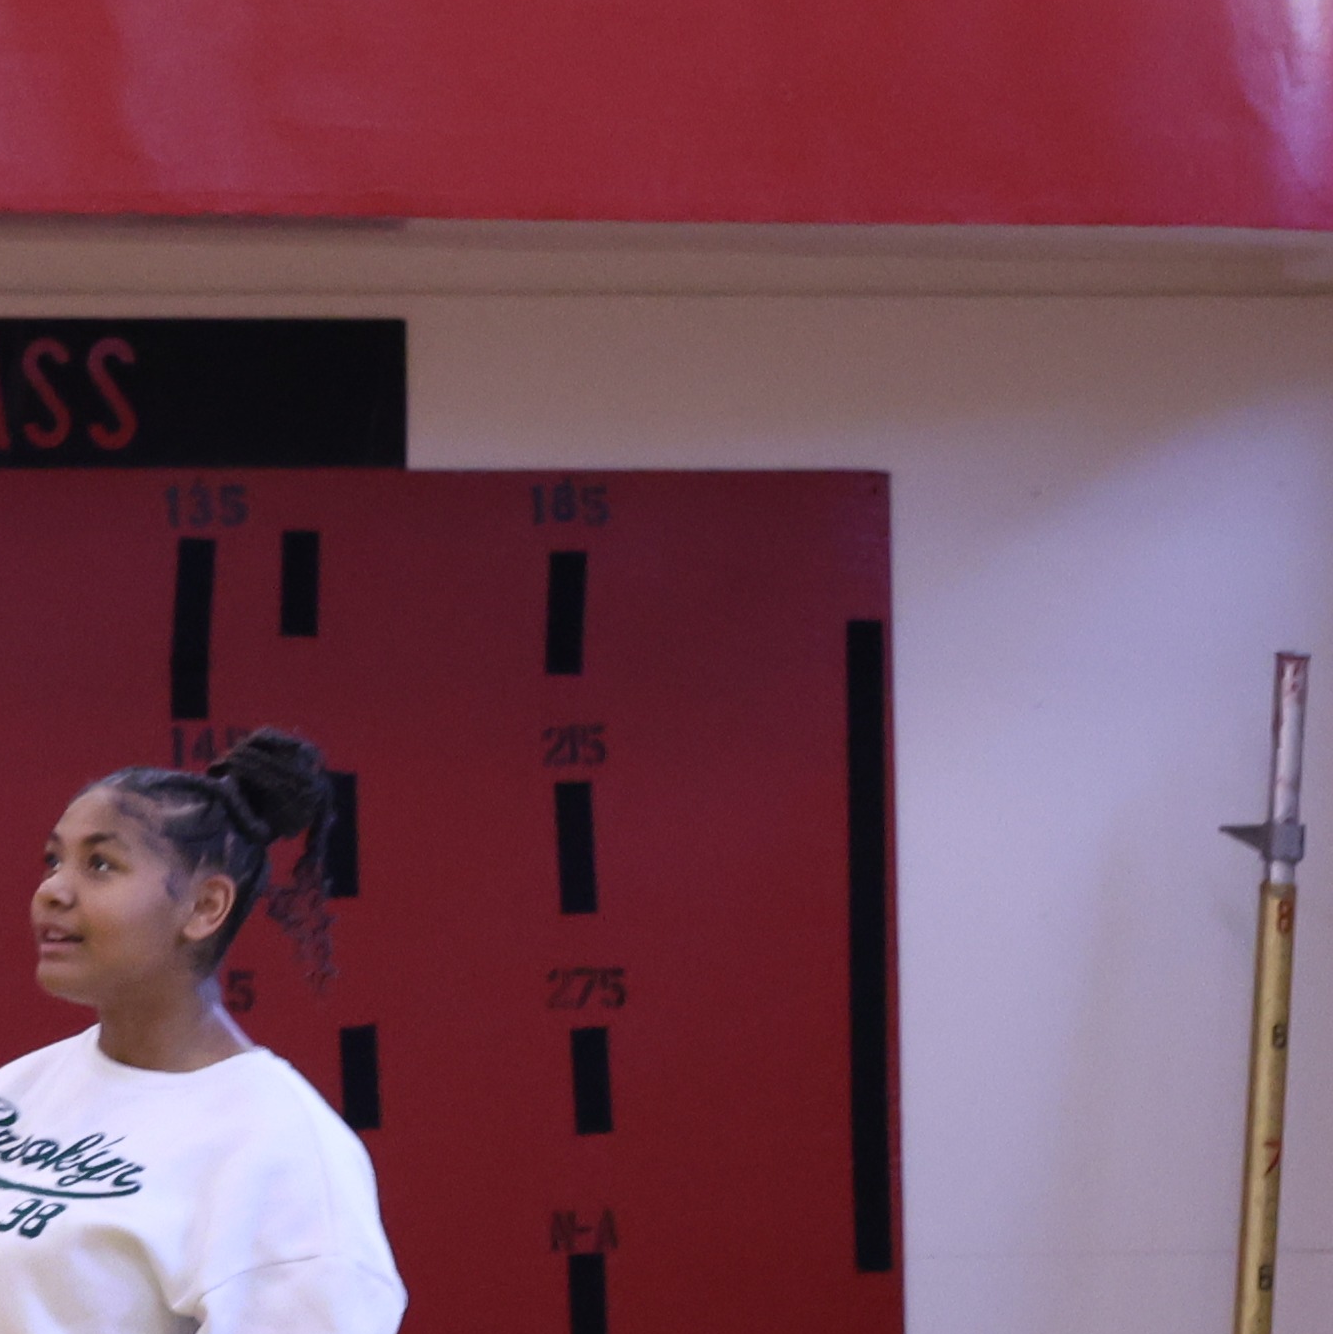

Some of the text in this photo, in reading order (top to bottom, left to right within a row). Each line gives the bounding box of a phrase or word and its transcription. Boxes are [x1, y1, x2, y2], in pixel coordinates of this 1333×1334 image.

[165, 483, 249, 528] 135
[531, 481, 610, 527] 185
[546, 966, 626, 1011] 275
